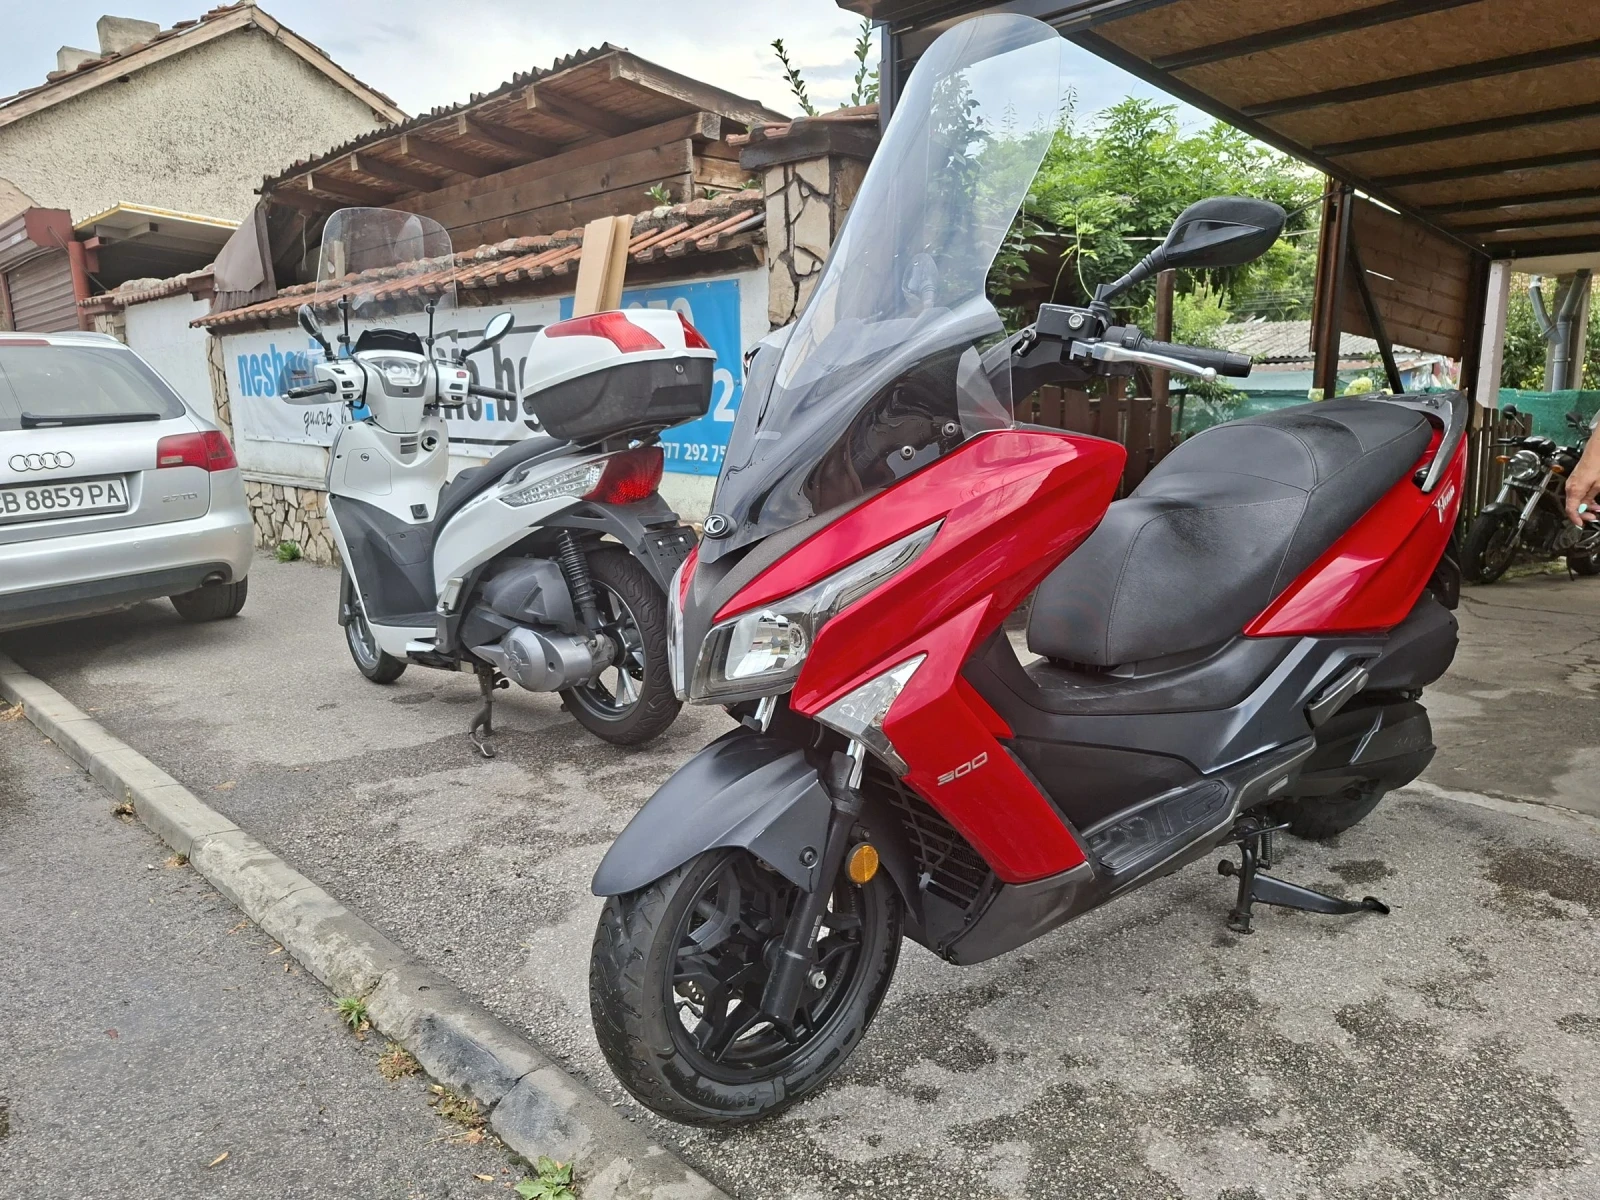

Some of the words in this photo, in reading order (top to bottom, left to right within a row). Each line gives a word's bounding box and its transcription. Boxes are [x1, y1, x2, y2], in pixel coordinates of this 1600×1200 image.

[684, 443, 708, 461] 292
[0, 491, 21, 514] B
[25, 486, 84, 511] 8859
[87, 483, 121, 505] PA
[937, 751, 988, 787] 300
